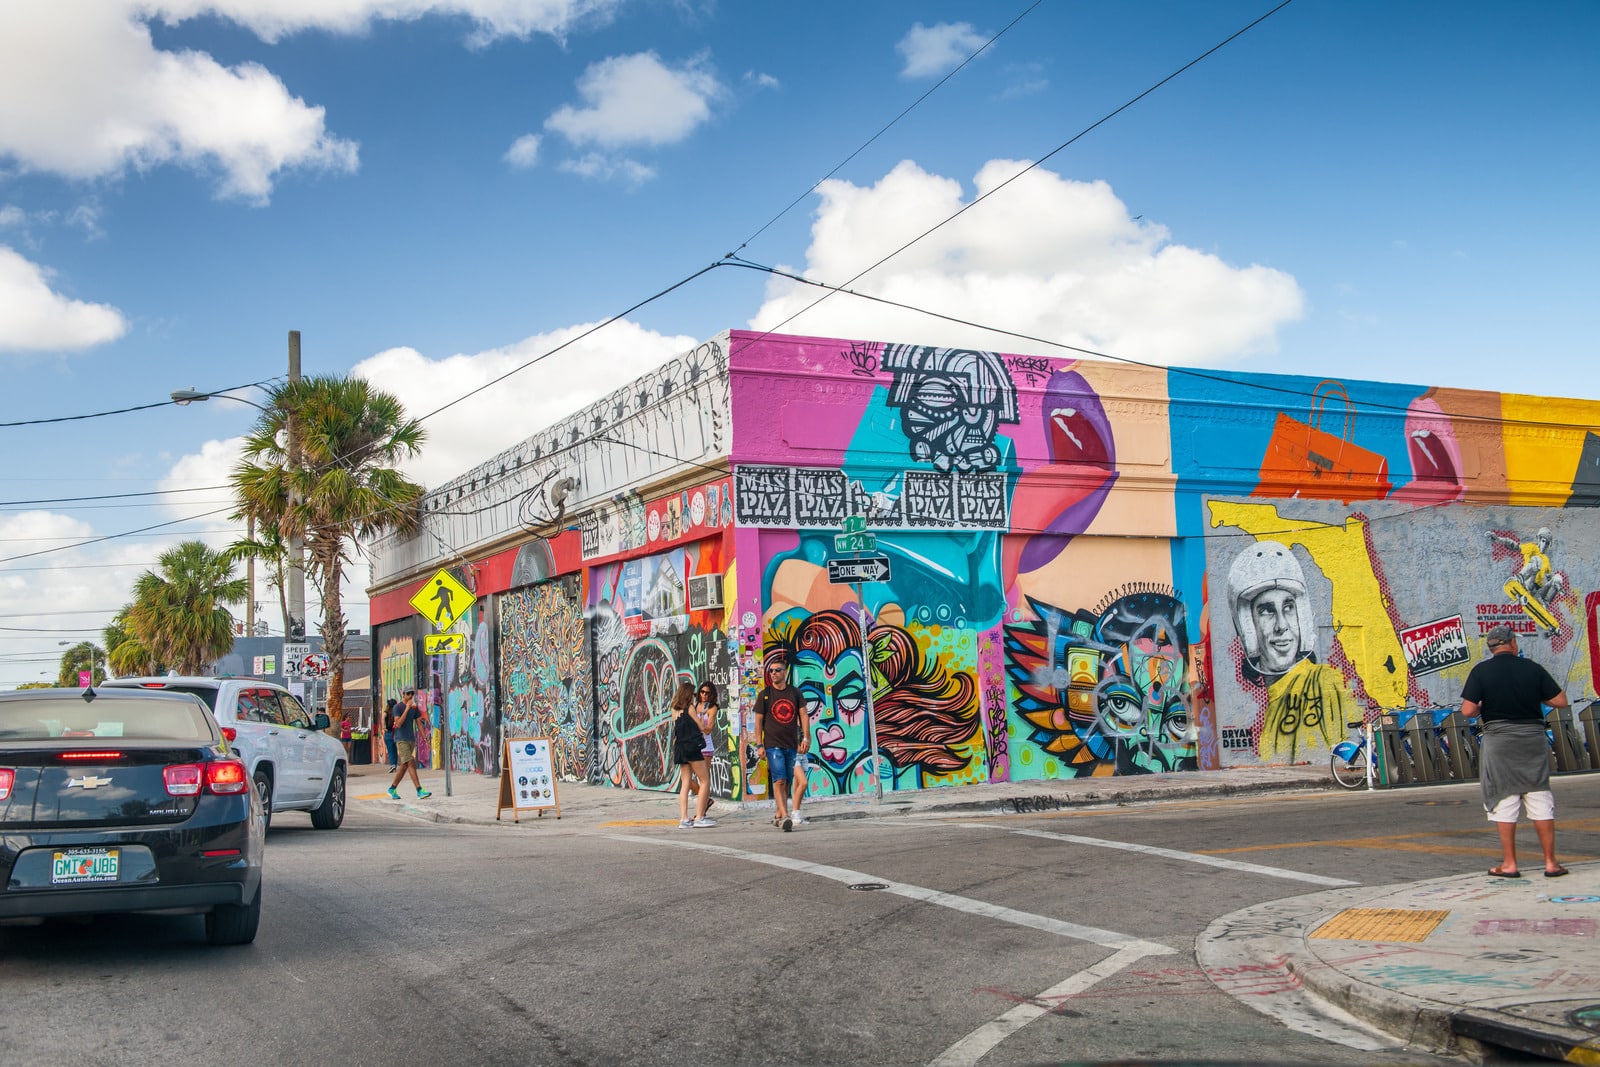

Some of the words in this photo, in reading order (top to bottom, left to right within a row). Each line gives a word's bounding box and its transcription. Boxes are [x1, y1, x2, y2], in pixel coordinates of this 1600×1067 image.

[740, 473, 786, 493] MAS
[798, 476, 843, 495] MAS
[909, 479, 950, 496] MAS
[960, 480, 1001, 498] MAS
[740, 492, 788, 516] PAZ
[799, 495, 844, 518] PAZ
[909, 496, 951, 519] PAZ
[960, 497, 1002, 520] PAZ
[837, 541, 847, 549] NW
[850, 537, 864, 550] 24
[870, 538, 875, 547] ST
[839, 566, 856, 576] ONE
[863, 565, 879, 575] WAY
[1475, 604, 1523, 614] 1978-2018
[1438, 646, 1462, 663] USA
[1222, 729, 1253, 739] BRYAN
[1223, 738, 1254, 748] DEESE
[52, 876, 117, 884] OceanAutoSales.com
